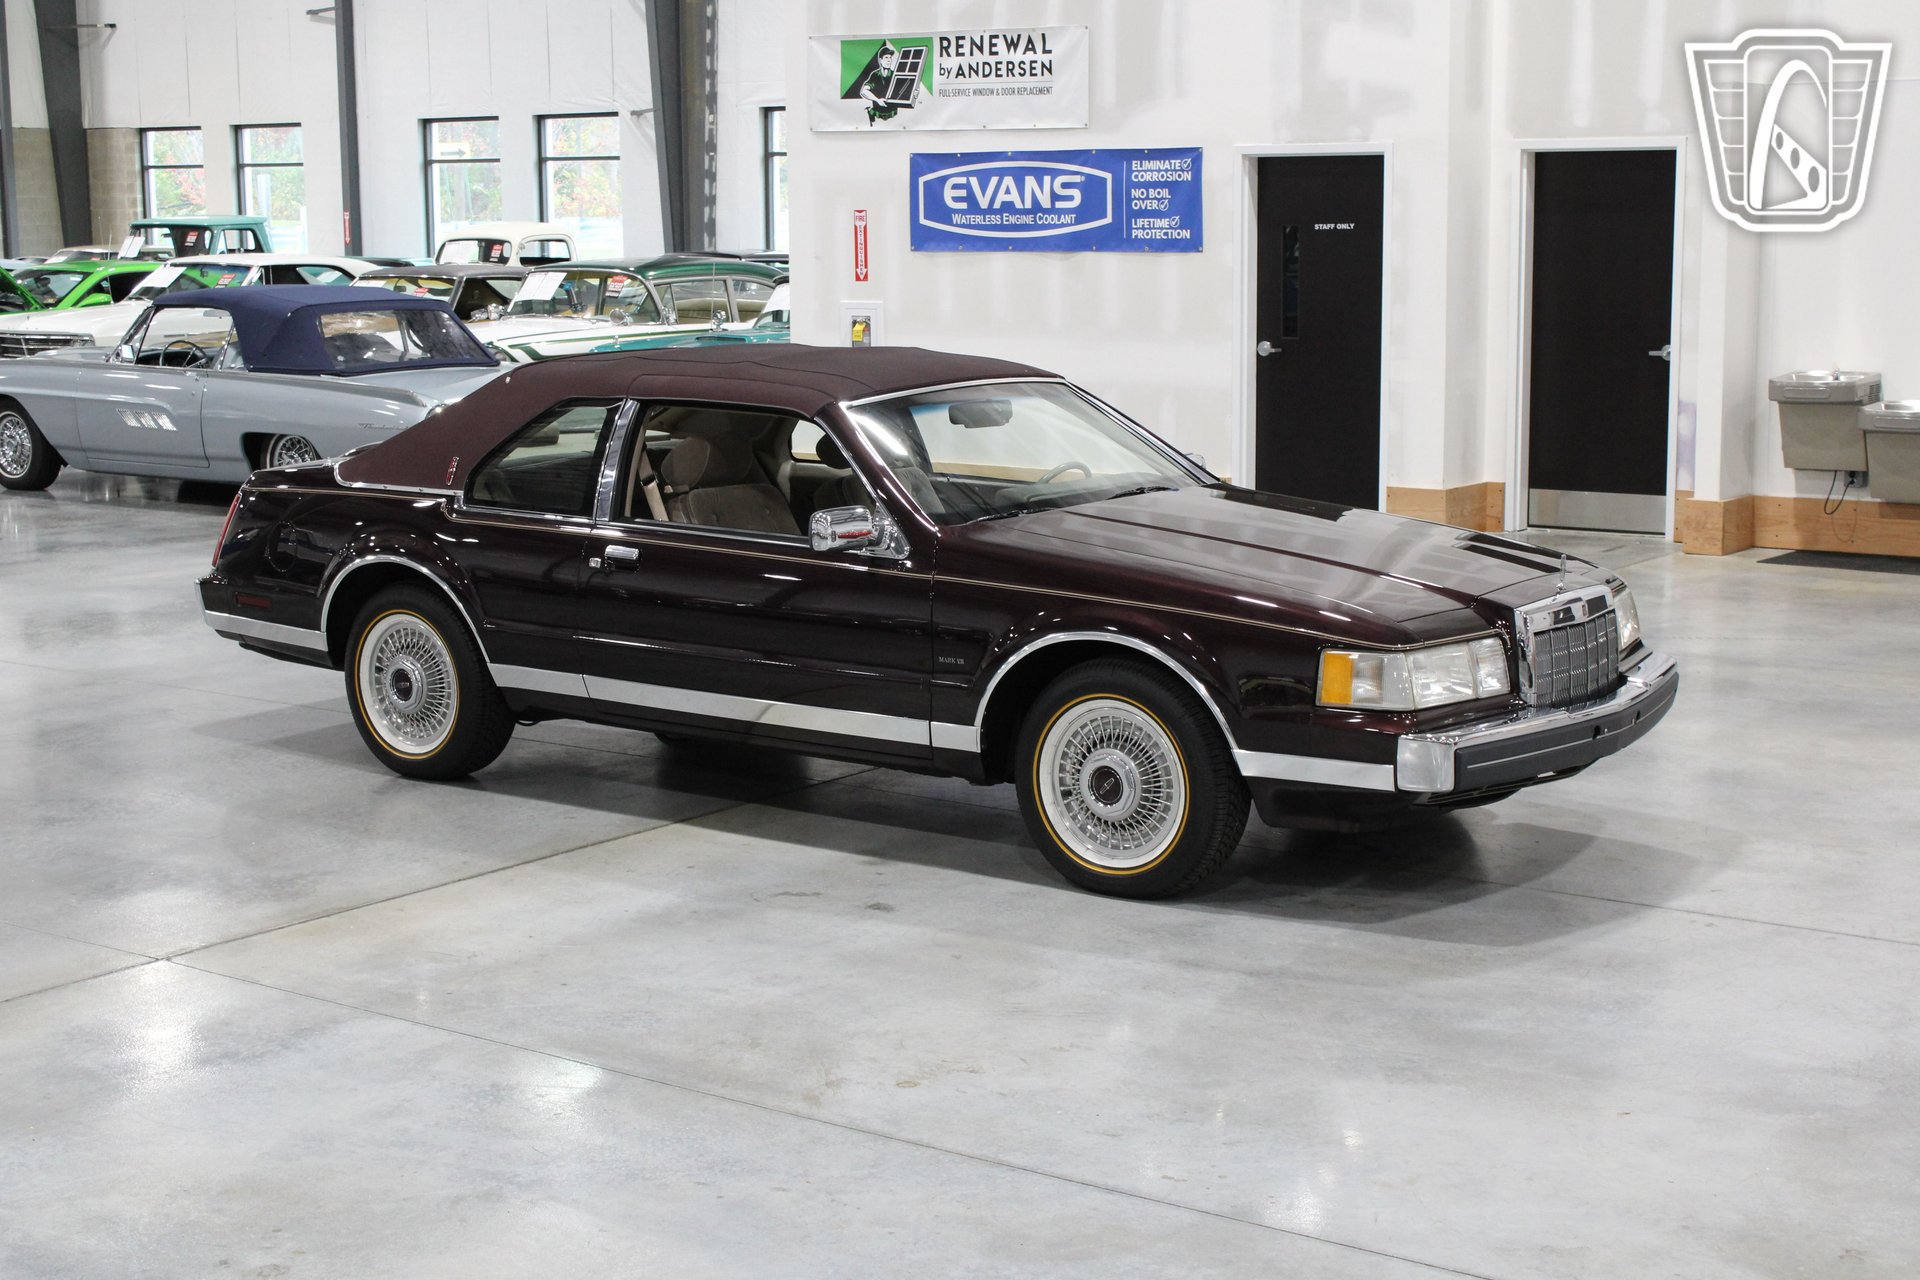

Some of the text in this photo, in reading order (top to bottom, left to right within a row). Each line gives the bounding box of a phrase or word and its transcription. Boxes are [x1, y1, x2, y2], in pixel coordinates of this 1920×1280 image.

[939, 33, 1052, 57] RENEWAL
[939, 60, 1052, 79] by ANDERSEN
[939, 86, 1053, 97] FULL-SERVICE WINDOW & DOOR REPLACEMENT
[1132, 160, 1181, 171] ELIMINATE
[1131, 171, 1192, 182] CORROSION
[943, 175, 1082, 209] EVANS
[1131, 188, 1171, 198] NO BOIL
[1132, 200, 1159, 210] OVER
[952, 213, 1076, 225] WATERLESS ENGINE COOLANT
[1132, 218, 1170, 228] LIFETIME
[1132, 229, 1190, 239] PROTECTION
[939, 656, 956, 664] MARK
